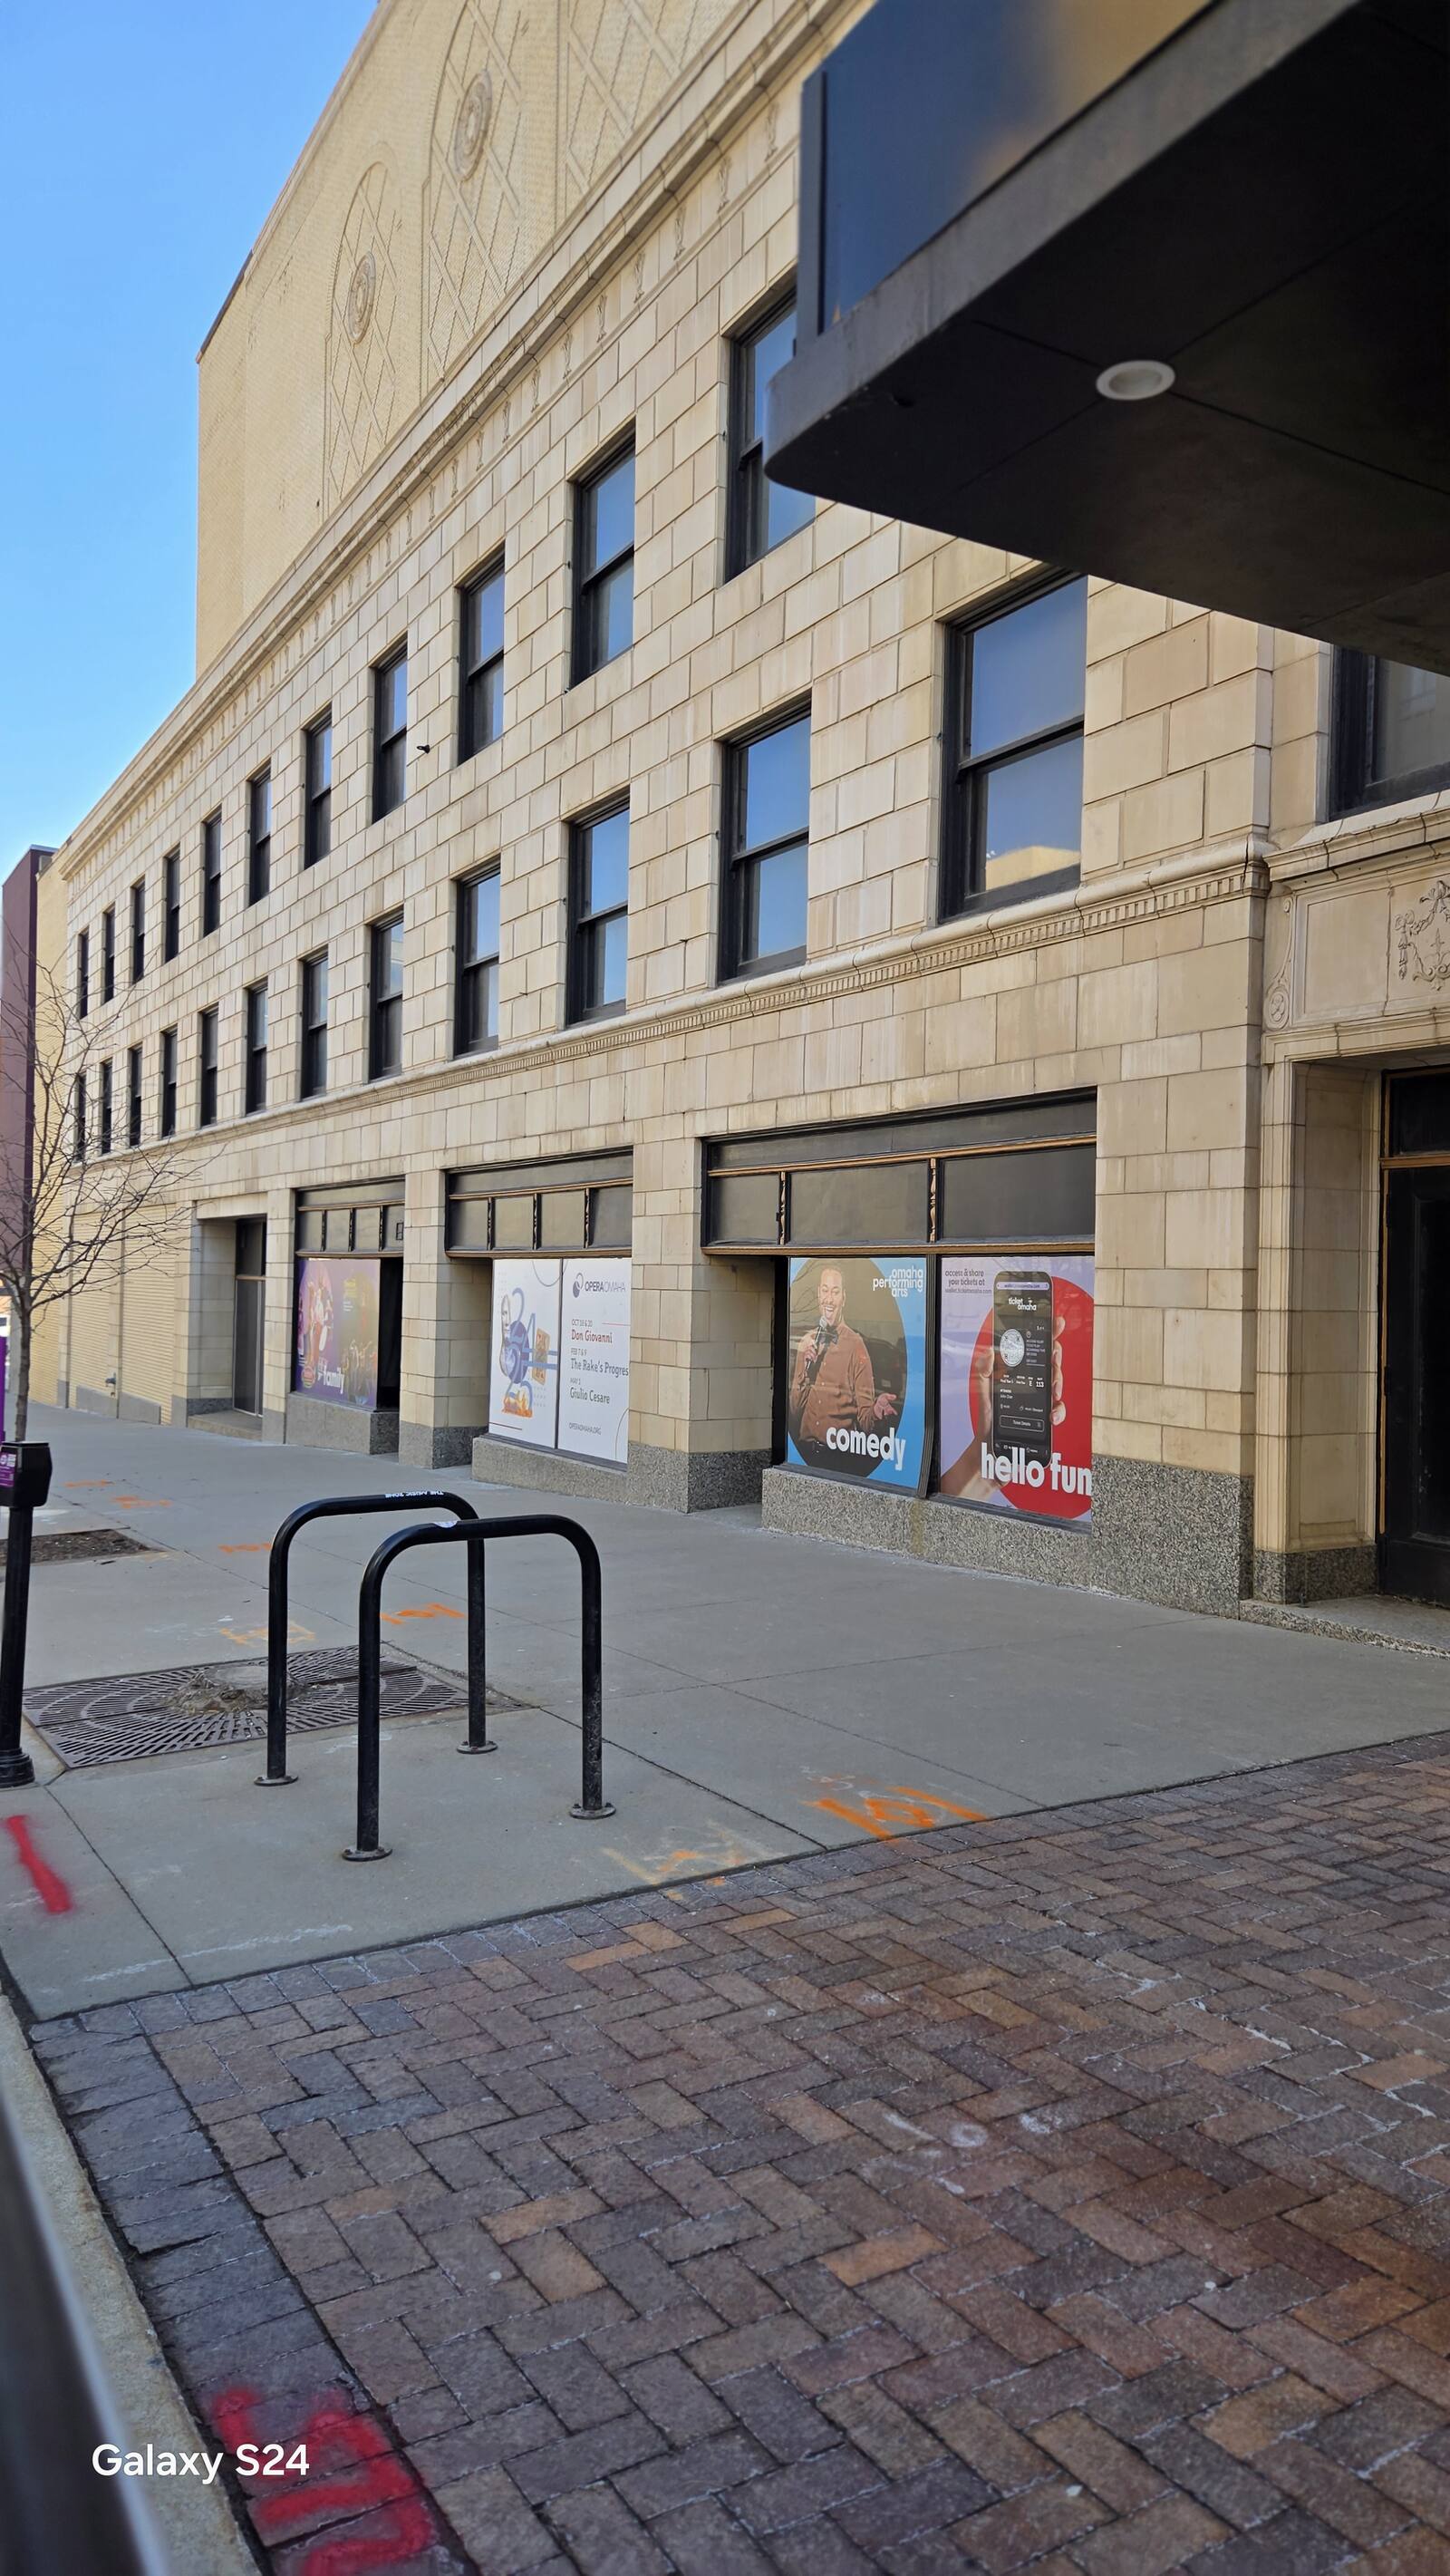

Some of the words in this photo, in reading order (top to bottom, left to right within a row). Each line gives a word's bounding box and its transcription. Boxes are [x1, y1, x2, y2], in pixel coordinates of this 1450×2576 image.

[891, 1264, 923, 1279] omaha
[964, 1269, 969, 1277] &
[969, 1269, 985, 1277] share
[873, 1274, 923, 1293] performing
[949, 1279, 960, 1287] your
[961, 1278, 978, 1287] tickets
[891, 1287, 908, 1297] arts
[1008, 1297, 1024, 1305] ticket
[1017, 1303, 1037, 1312] omaha
[572, 1329, 584, 1341] Don
[585, 1330, 613, 1343] Giovanni
[571, 1358, 582, 1370] The
[583, 1359, 604, 1373] Rake's
[604, 1361, 629, 1378] Progres
[323, 1365, 344, 1395] family
[570, 1387, 588, 1400] Giulio
[589, 1390, 610, 1404] Cesare
[568, 1422, 602, 1435] OPERAOMAHA.ORG
[826, 1427, 906, 1471] comedy
[981, 1442, 1045, 1488] hello
[1050, 1452, 1092, 1496] fun
